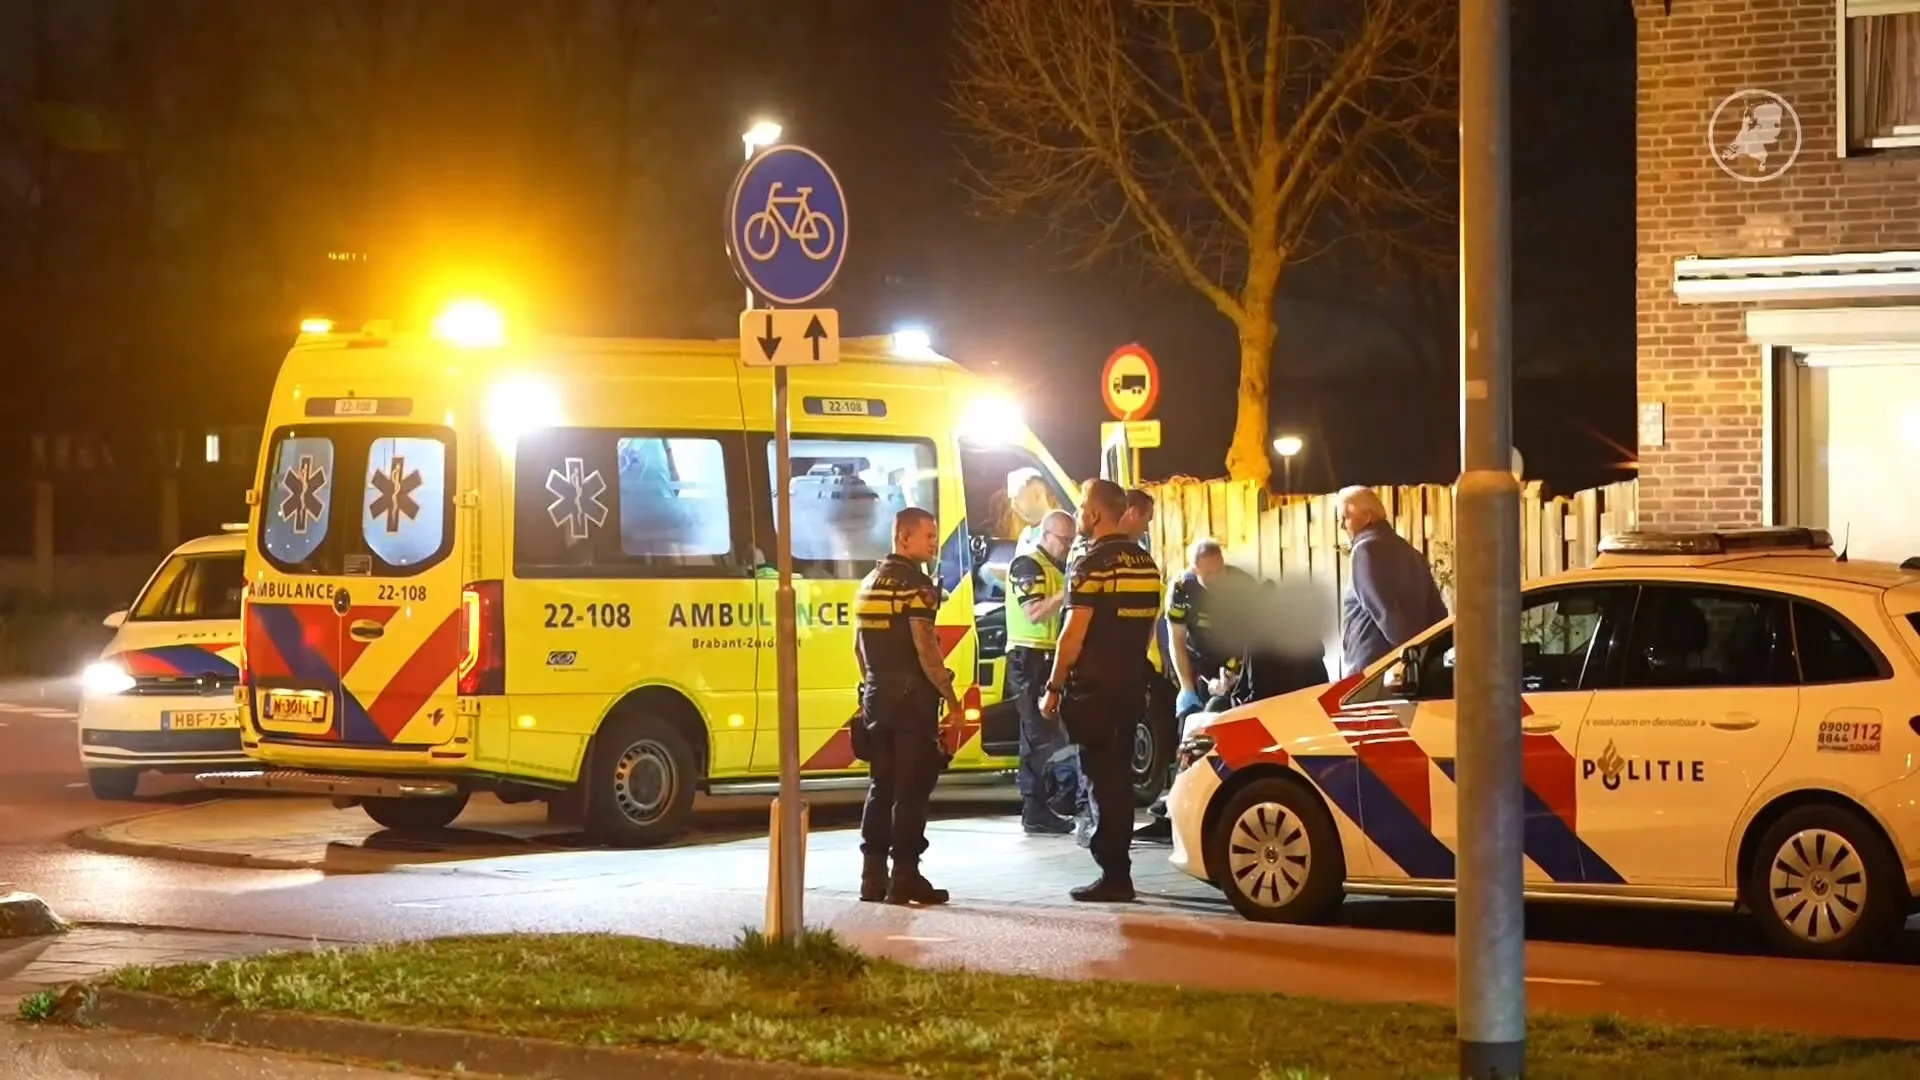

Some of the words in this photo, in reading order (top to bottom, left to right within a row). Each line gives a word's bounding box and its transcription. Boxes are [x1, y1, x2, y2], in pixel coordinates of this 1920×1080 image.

[829, 401, 863, 412] 22-108
[248, 582, 335, 599] AMBULANCE
[378, 584, 427, 601] 22-108
[544, 603, 631, 628] 22-108
[669, 602, 850, 627] AMBULNCE
[691, 637, 802, 649] Brabant-Zuidt
[1819, 720, 1850, 732] 0900
[1851, 722, 1882, 741] 112
[1583, 759, 1705, 791] POLITIE
